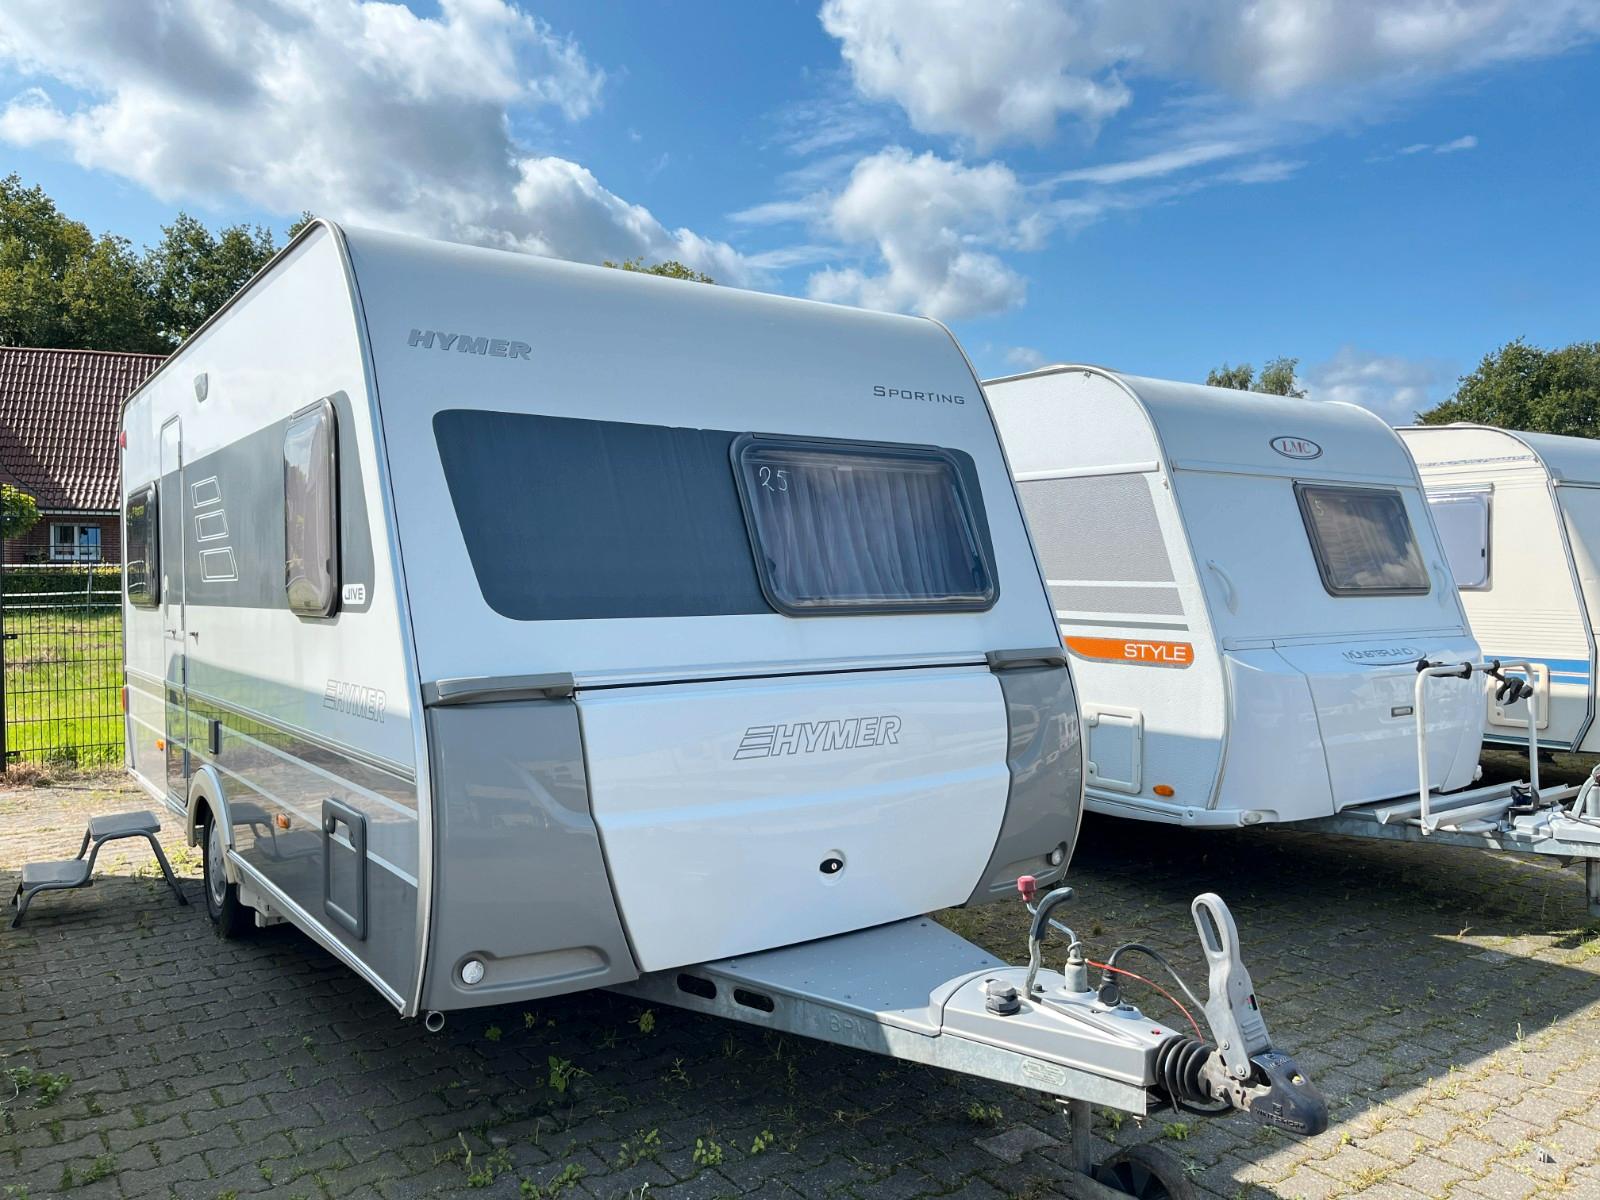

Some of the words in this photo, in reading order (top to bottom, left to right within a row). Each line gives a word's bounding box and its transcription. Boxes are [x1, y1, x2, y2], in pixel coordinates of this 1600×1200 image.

[407, 328, 532, 361] HYMER
[1281, 440, 1313, 454] LMC
[759, 466, 791, 491] 25
[344, 587, 363, 600] JIVE
[1124, 643, 1186, 662] STYLE
[335, 680, 386, 723] HYMER
[771, 715, 902, 757] HYMER
